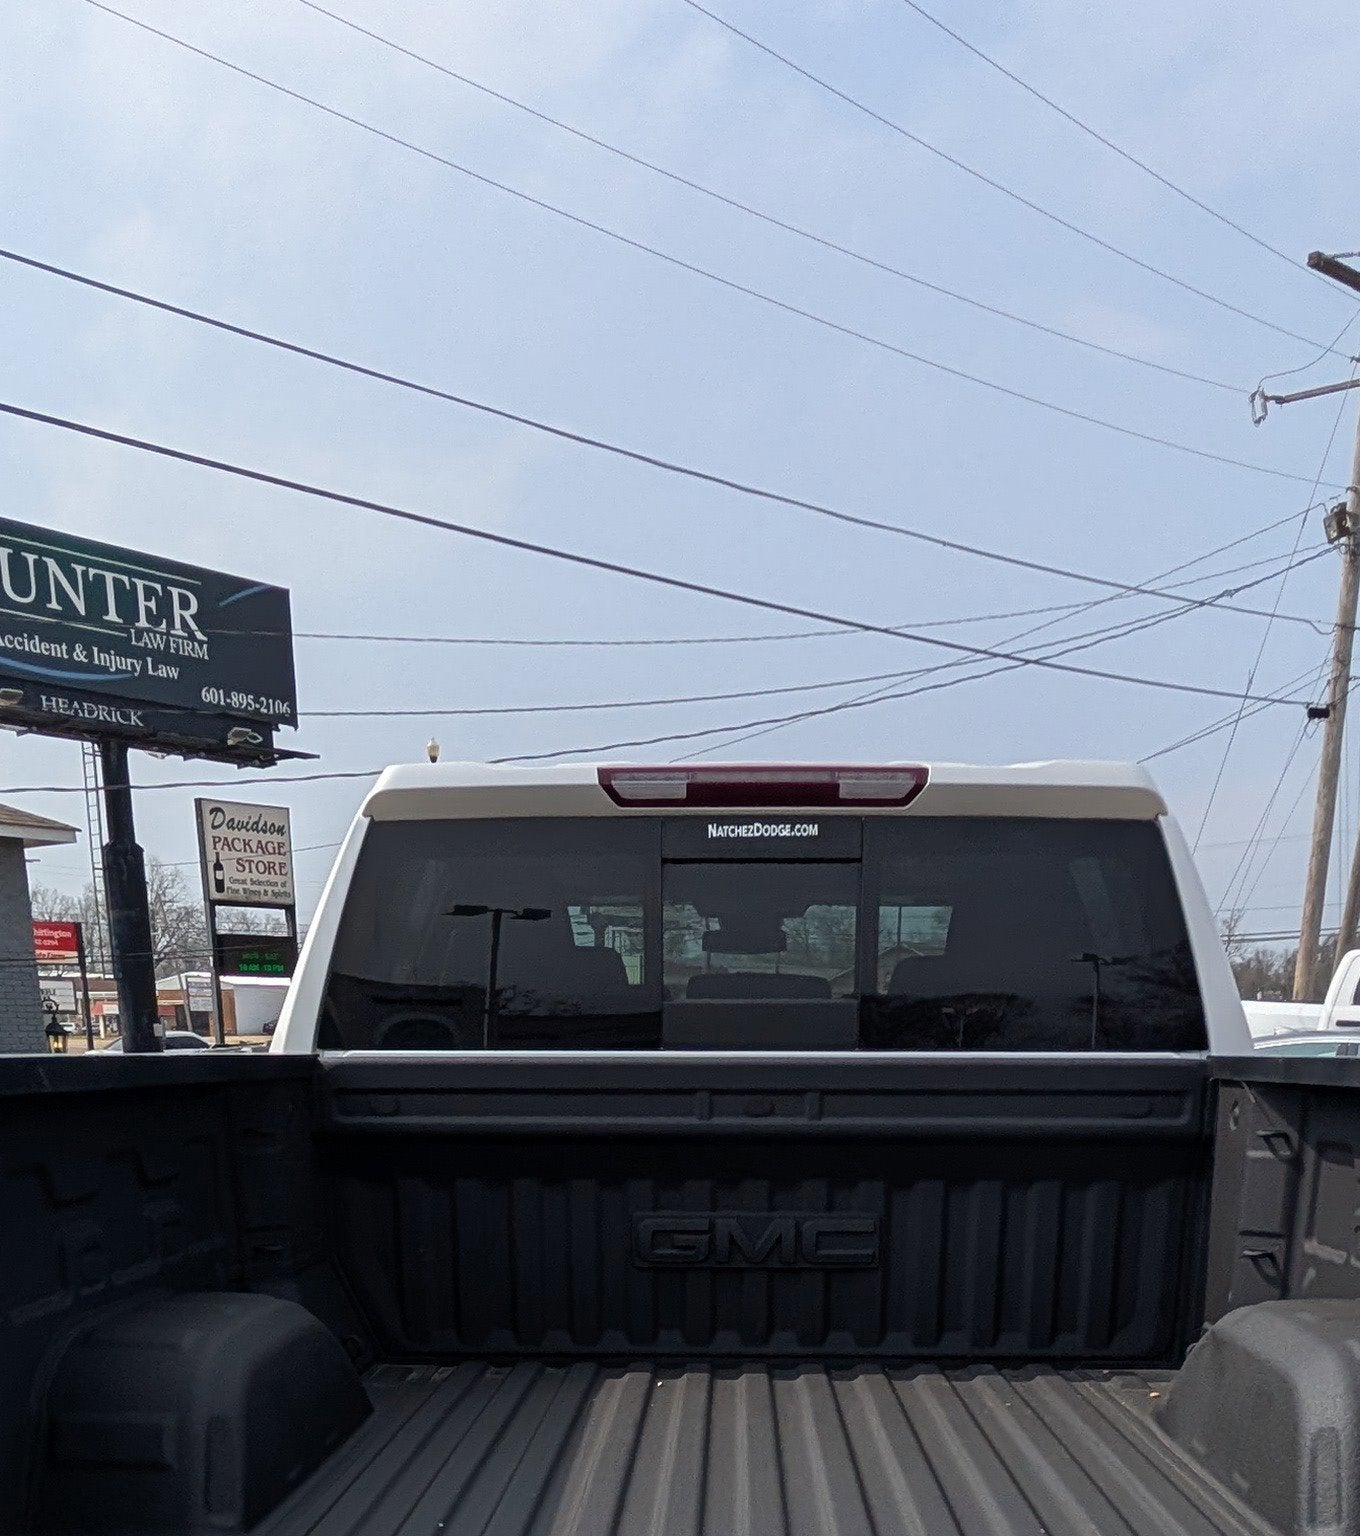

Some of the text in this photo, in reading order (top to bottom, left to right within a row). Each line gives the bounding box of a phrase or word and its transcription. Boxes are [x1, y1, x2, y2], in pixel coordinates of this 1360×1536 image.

[130, 628, 209, 660] LAW FIRM
[73, 643, 89, 662] &
[92, 646, 143, 676] Injury
[147, 657, 180, 680] Law
[201, 686, 291, 715] 601-895-2106
[209, 806, 287, 837] Davidson
[211, 835, 287, 857] PACKAGE
[235, 857, 288, 876] STORE
[639, 1217, 877, 1264] GMC
